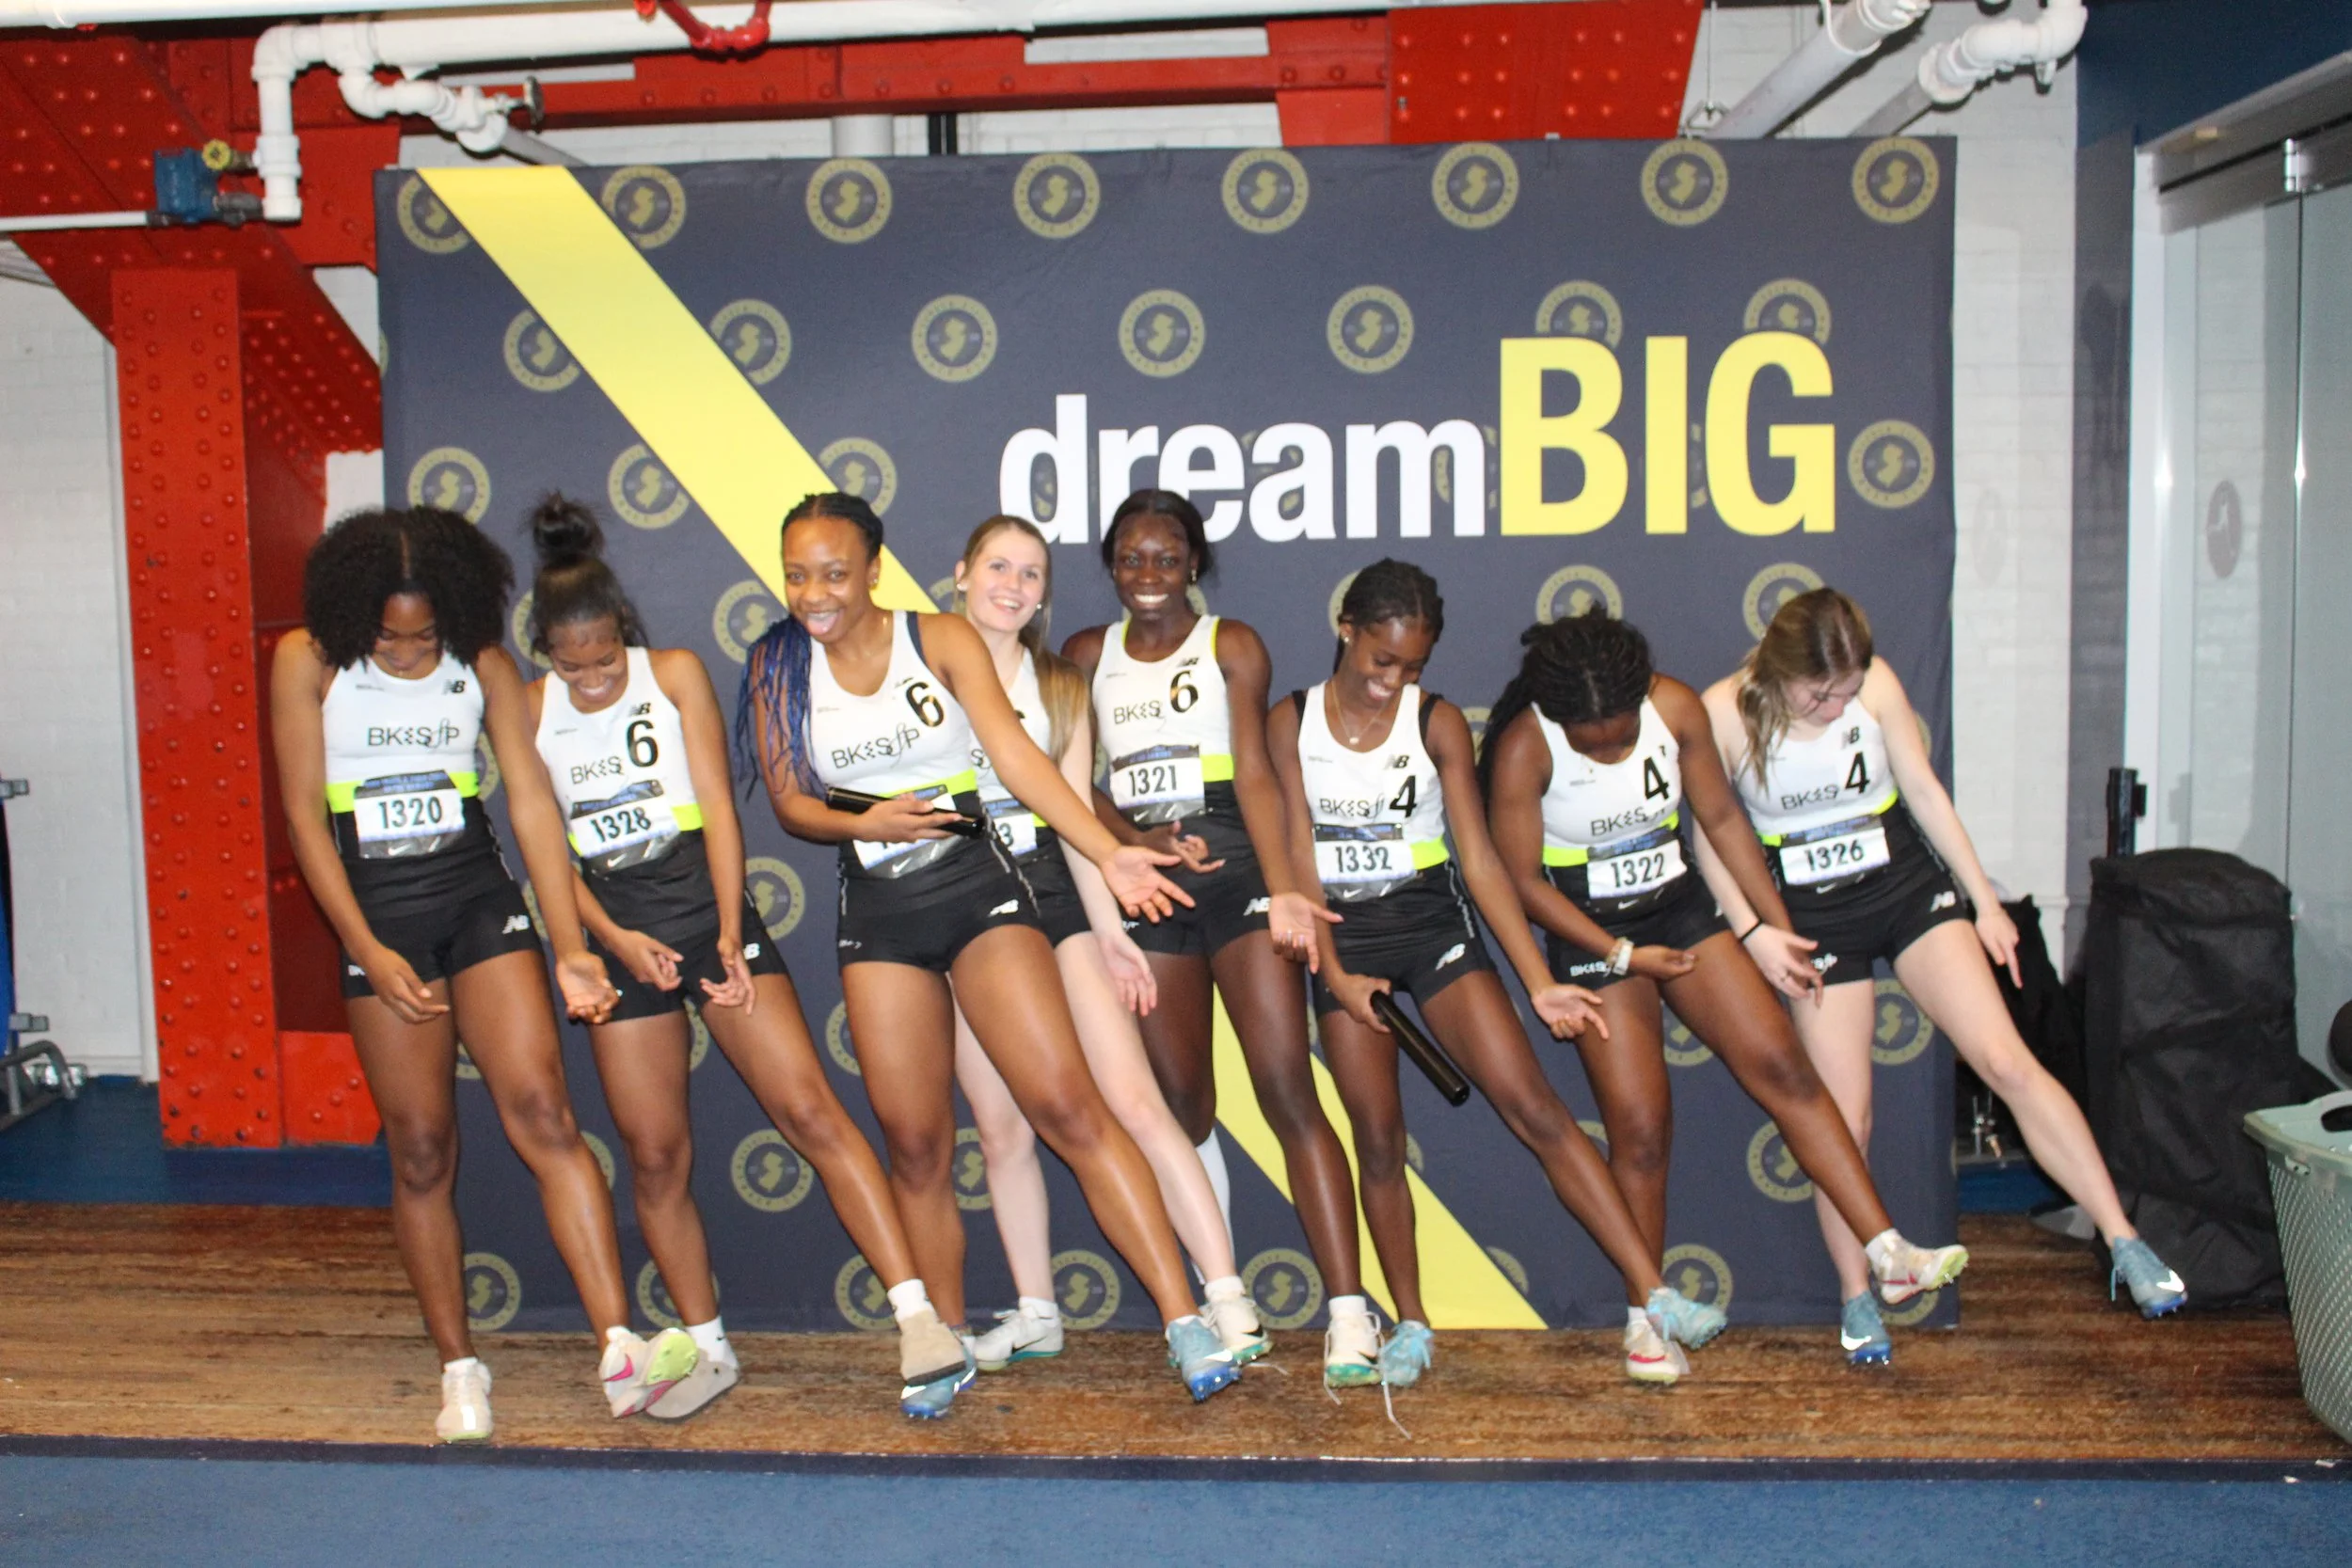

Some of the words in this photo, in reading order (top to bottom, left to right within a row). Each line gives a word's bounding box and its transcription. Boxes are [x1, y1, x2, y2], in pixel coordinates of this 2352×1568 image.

[905, 682, 945, 728] 6
[1169, 670, 1199, 714] 6
[627, 720, 659, 768] 6
[1128, 765, 1177, 798] 1321
[1644, 756, 1670, 800] 4
[1845, 752, 1870, 794] 4
[378, 795, 442, 829] 1320
[1389, 775, 1418, 818] 4
[590, 807, 651, 843] 1328
[1335, 845, 1392, 873] 1332
[1611, 852, 1664, 888] 1322
[1804, 839, 1864, 871] 1326
